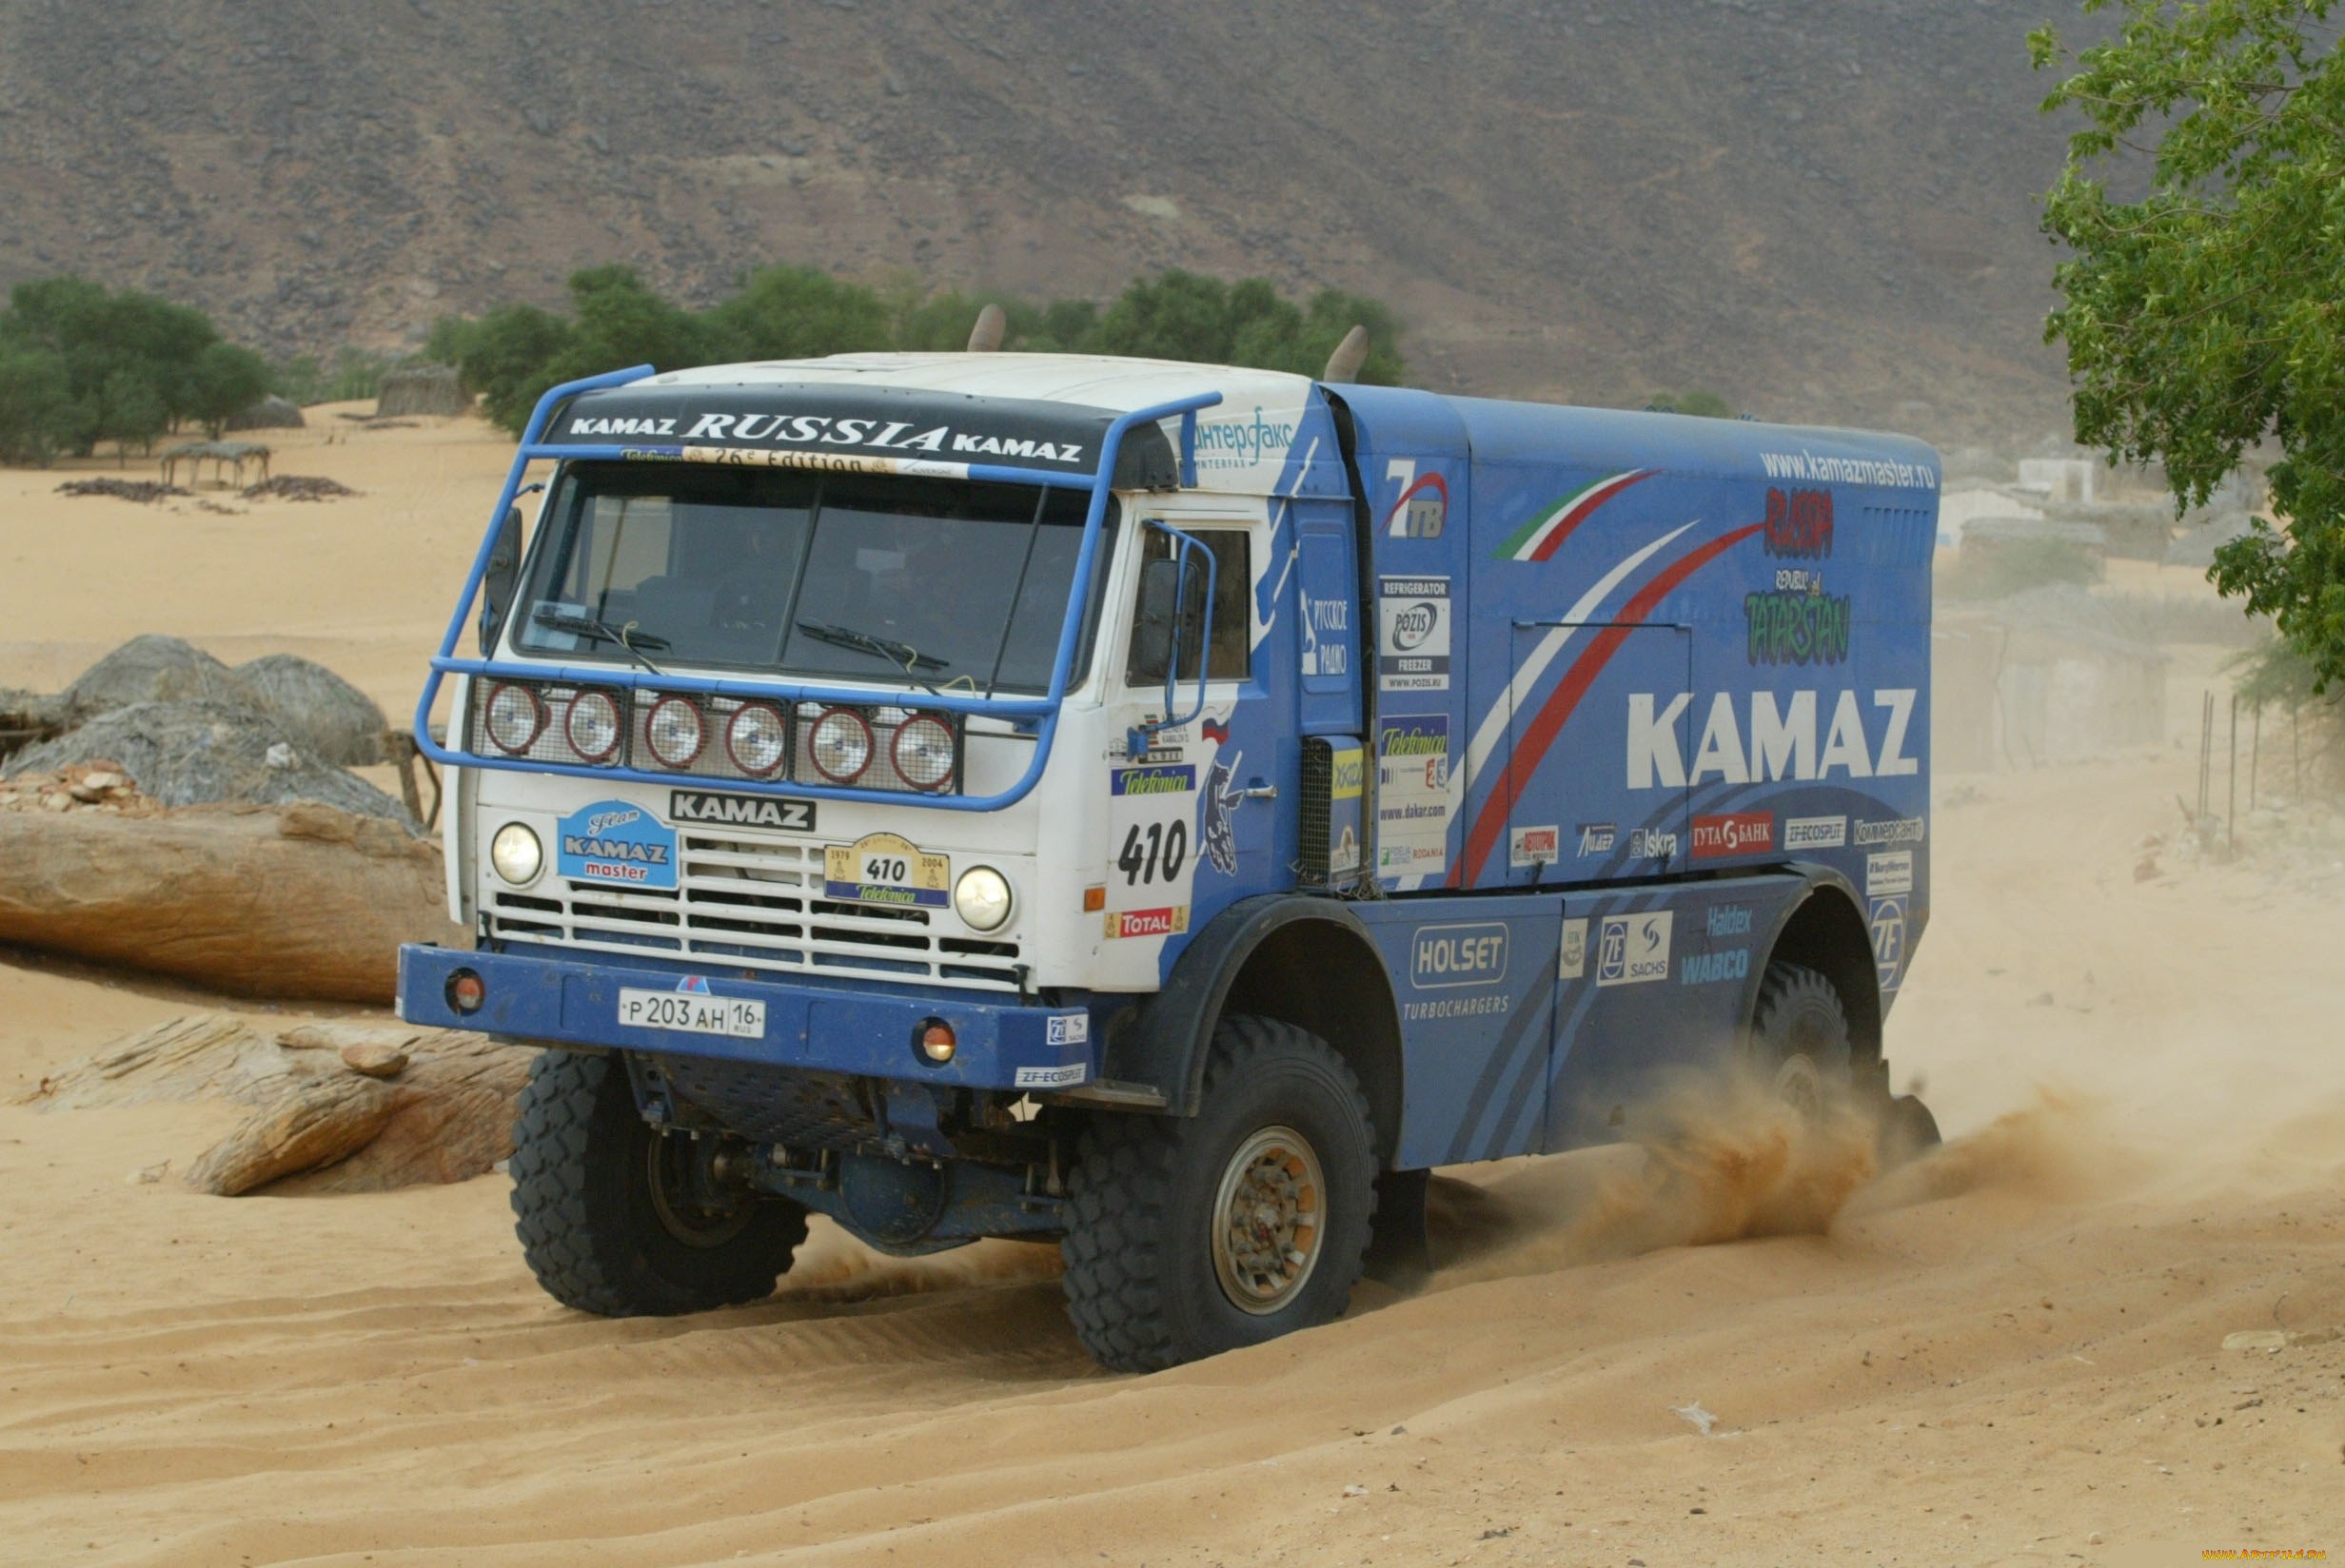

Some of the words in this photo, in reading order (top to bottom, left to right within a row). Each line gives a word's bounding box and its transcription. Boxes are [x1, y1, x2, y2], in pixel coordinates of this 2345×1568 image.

[570, 418, 677, 435] KAMAZ
[679, 413, 950, 452] RUSSIA
[953, 434, 1083, 462] KAMAZ
[1197, 459, 1247, 470] INTERFAX
[1761, 449, 1937, 489] www.kamazmaster.ru
[1385, 582, 1446, 595] REFRIGERATOR
[1396, 614, 1426, 632] POZIS
[1745, 591, 1850, 666] TATARSTAN
[1398, 658, 1432, 671] FREEZER
[1627, 689, 1919, 789] KAMAZ
[587, 809, 640, 836] Team
[673, 794, 809, 827] KAMAZ
[1380, 803, 1446, 820] www.dakar.com
[1645, 827, 1677, 857] Iskra
[1693, 826, 1722, 847] ГУТА
[1739, 823, 1771, 843] БАНК
[563, 834, 669, 865] KAMAZ
[831, 850, 850, 860] 1979
[1118, 819, 1187, 886] 410
[586, 862, 648, 880] master
[867, 858, 905, 882] 410
[921, 857, 943, 868] 2004
[1122, 914, 1171, 933] TOTAL
[1706, 905, 1752, 936] Haldex
[1417, 936, 1504, 974] HOLSET
[1631, 960, 1665, 977] SACHS
[1681, 949, 1749, 986] WABCO
[733, 1004, 756, 1025] 16
[1404, 995, 1509, 1020] TURBOCHARGERS
[734, 1025, 752, 1034] RUS
[1022, 1068, 1083, 1083] ZF-ECOSPLIT
